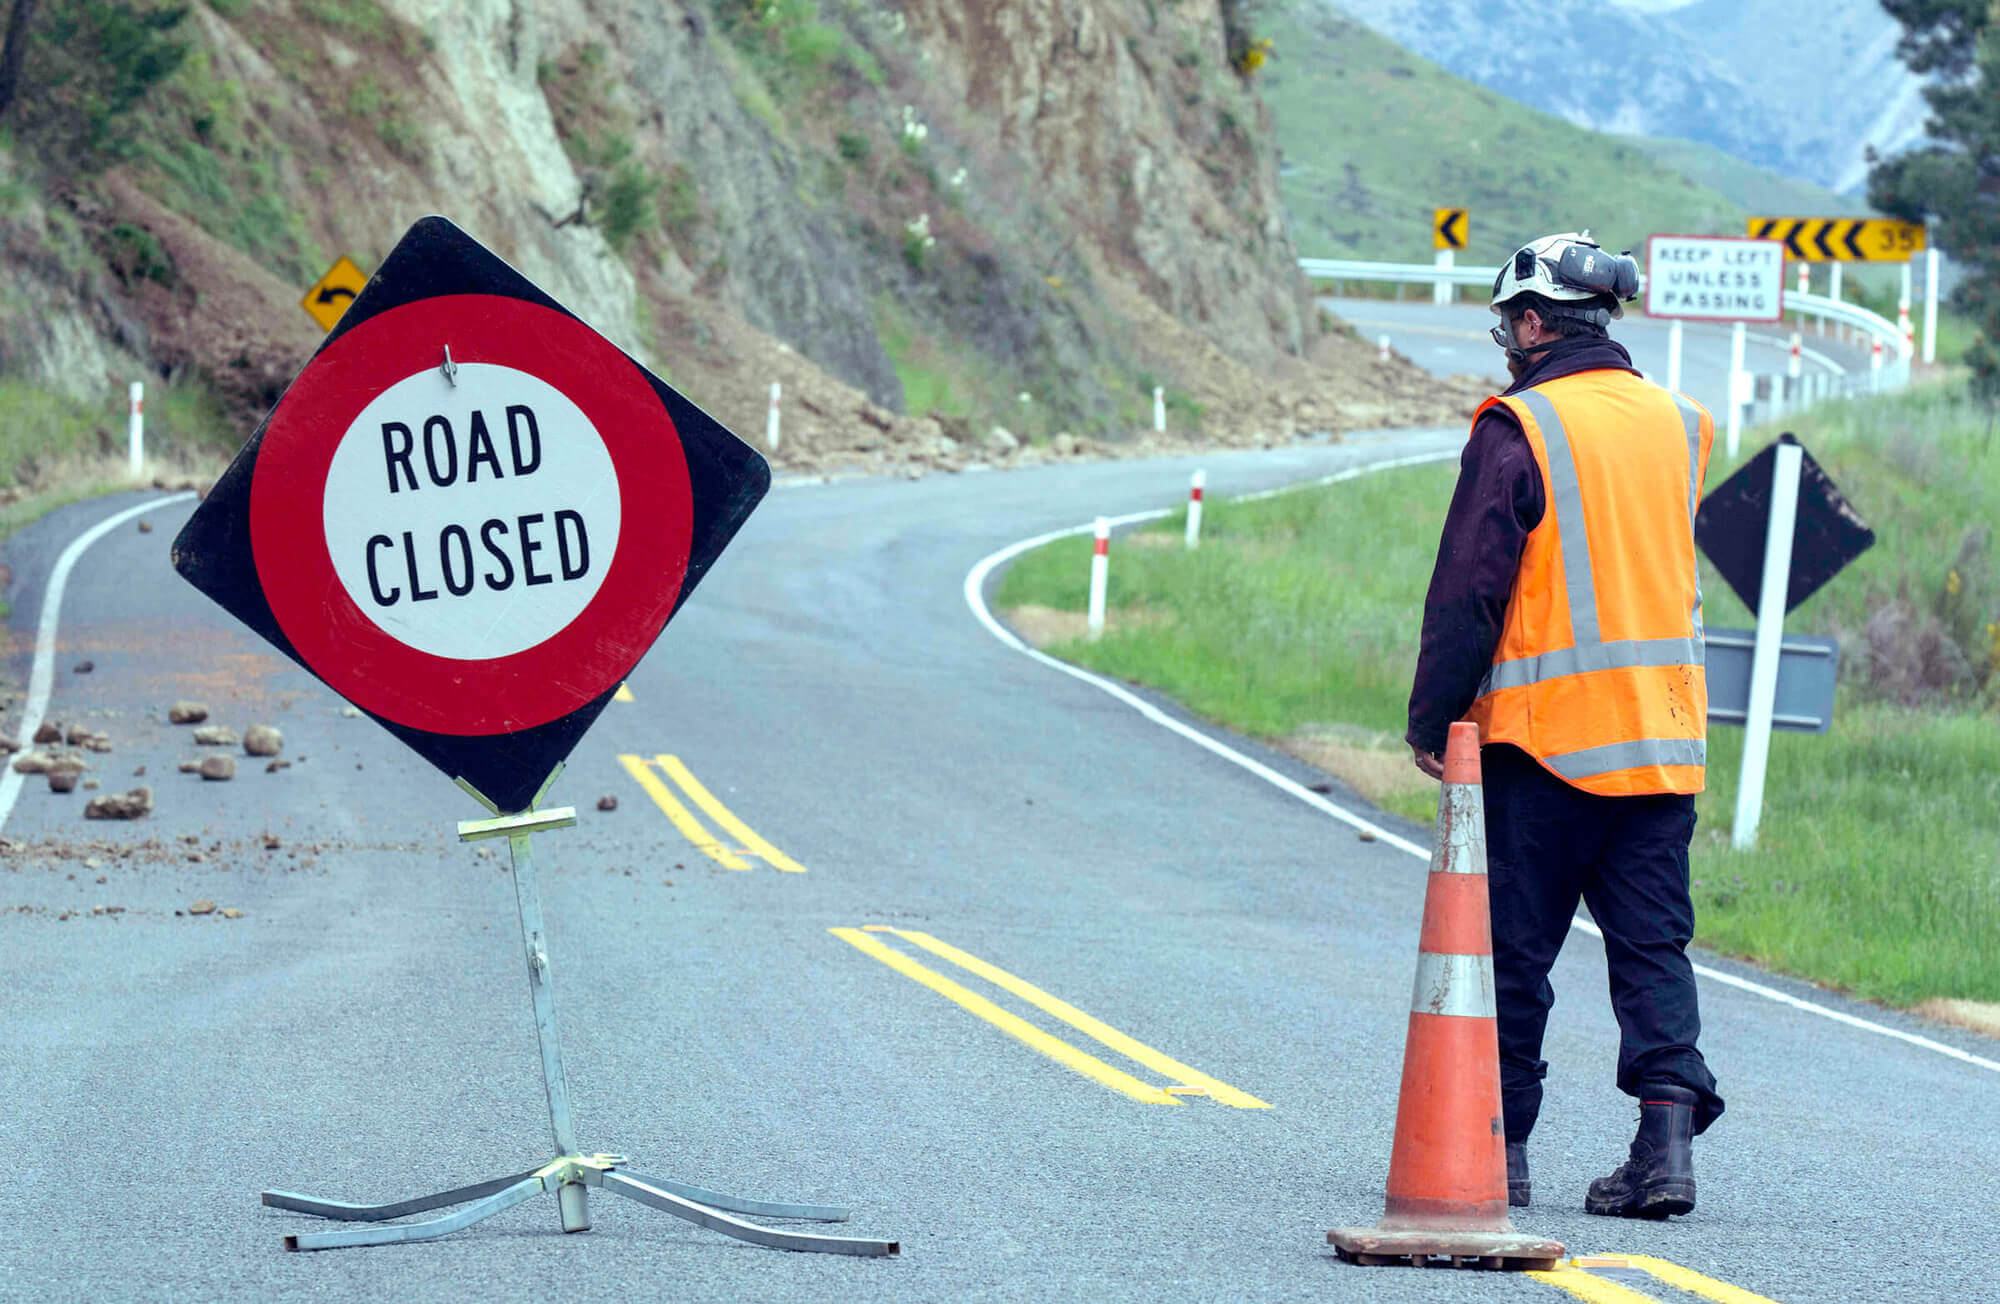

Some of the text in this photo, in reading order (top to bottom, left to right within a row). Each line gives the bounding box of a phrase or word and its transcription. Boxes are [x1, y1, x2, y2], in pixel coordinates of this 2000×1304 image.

[1880, 228, 1916, 251] 35
[1660, 247, 1772, 266] KEEP LEFT
[1669, 271, 1762, 289] UNLESS
[1663, 291, 1765, 311] PASSING
[381, 404, 542, 493] ROAD
[366, 509, 590, 607] CLOSED
